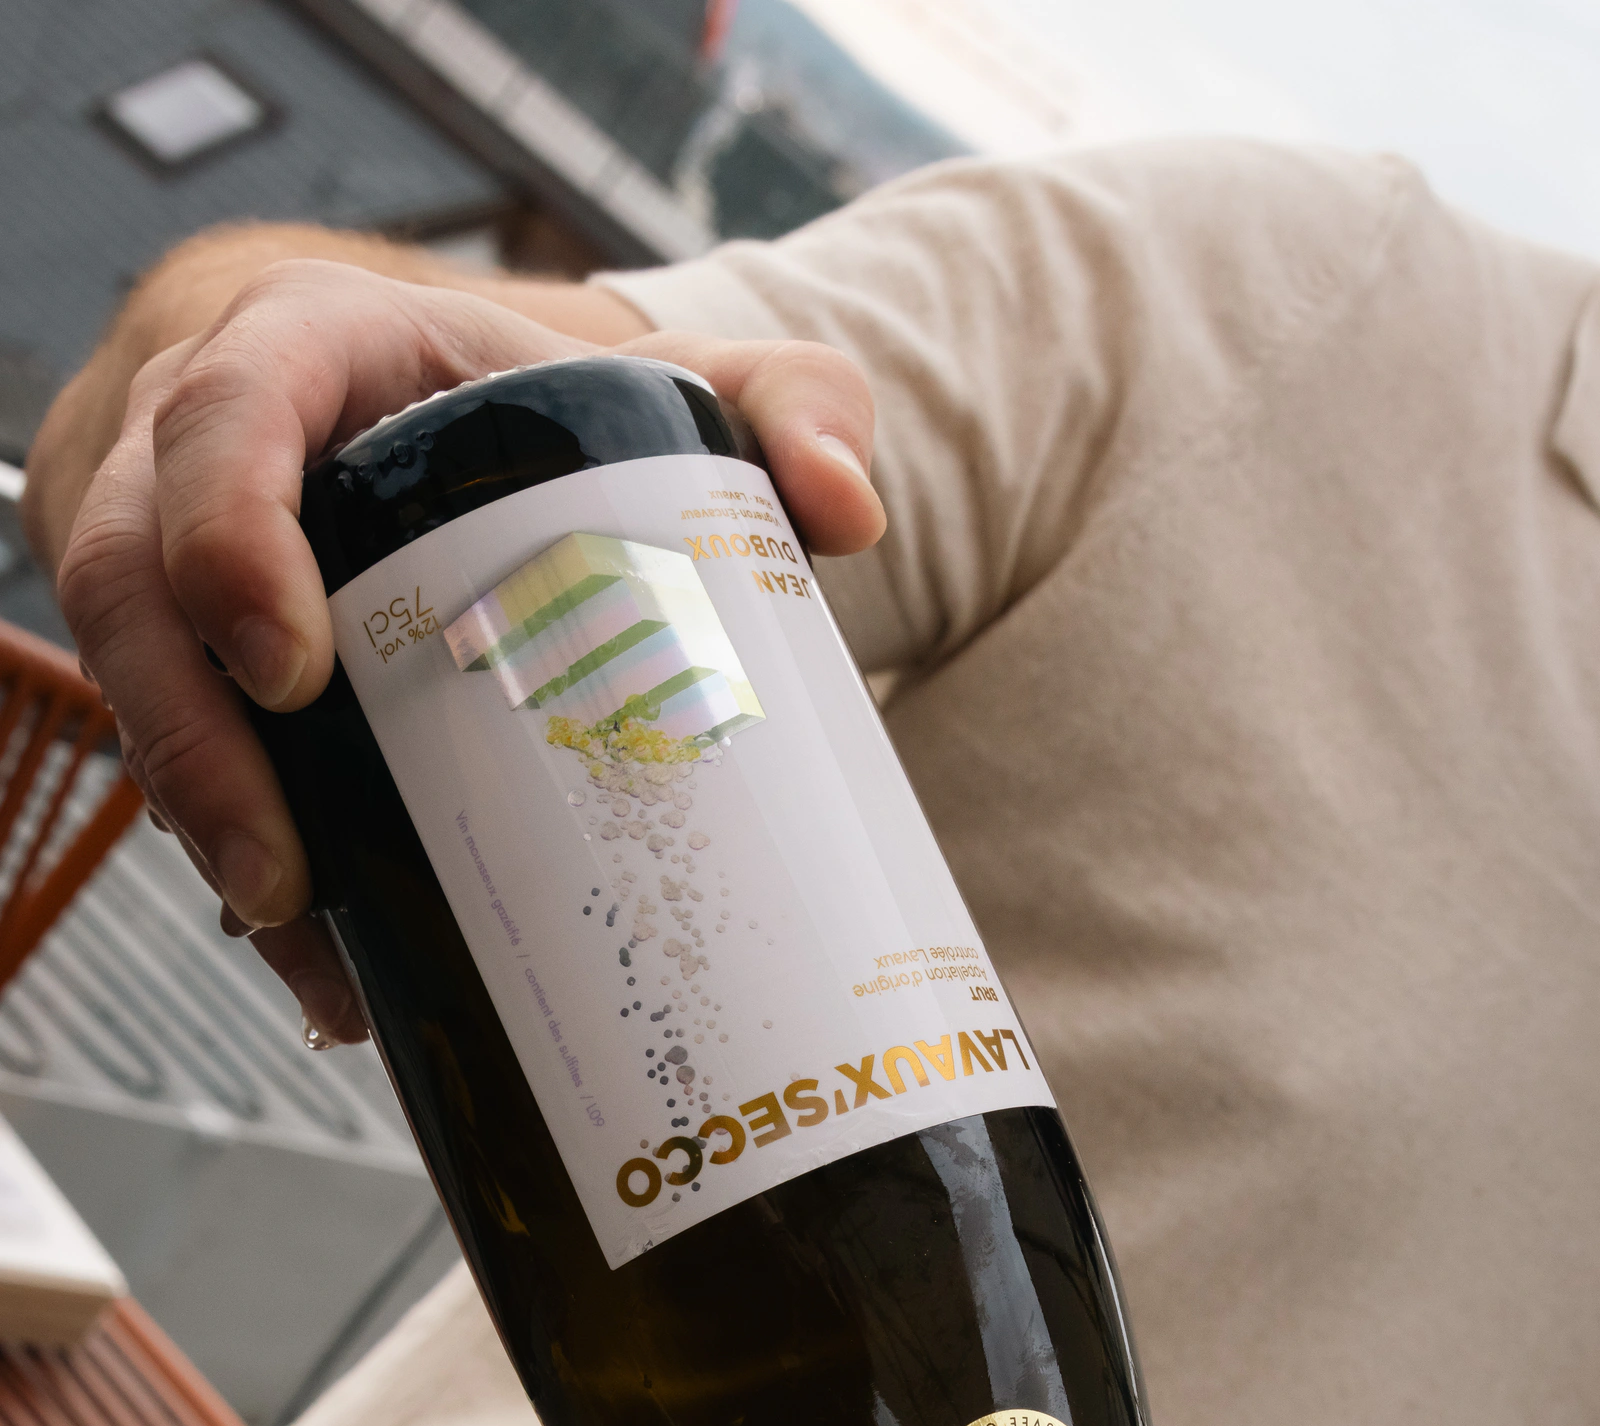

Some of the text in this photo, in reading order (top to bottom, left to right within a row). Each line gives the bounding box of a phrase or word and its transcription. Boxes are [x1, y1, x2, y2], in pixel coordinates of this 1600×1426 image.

[708, 490, 749, 504] Lavaux
[680, 508, 782, 528] Vigneron-Encaveur
[683, 534, 798, 564] DUBOUX
[751, 570, 811, 599] JEAN
[363, 586, 433, 648] 75cl
[376, 615, 442, 664] 12% vol.
[455, 809, 469, 833] Vin
[464, 835, 497, 897] mousseux
[490, 899, 523, 947] gazéifié
[525, 967, 553, 1019] contient
[548, 1019, 563, 1043] des
[559, 1044, 583, 1088] sulfites
[586, 1103, 605, 1128] L09
[873, 946, 979, 969] contrôlée Lavaux
[852, 966, 988, 997] Appellation d'origine
[969, 986, 999, 1002] BRUT
[616, 1028, 1031, 1208] LAVAUX'SECCO
